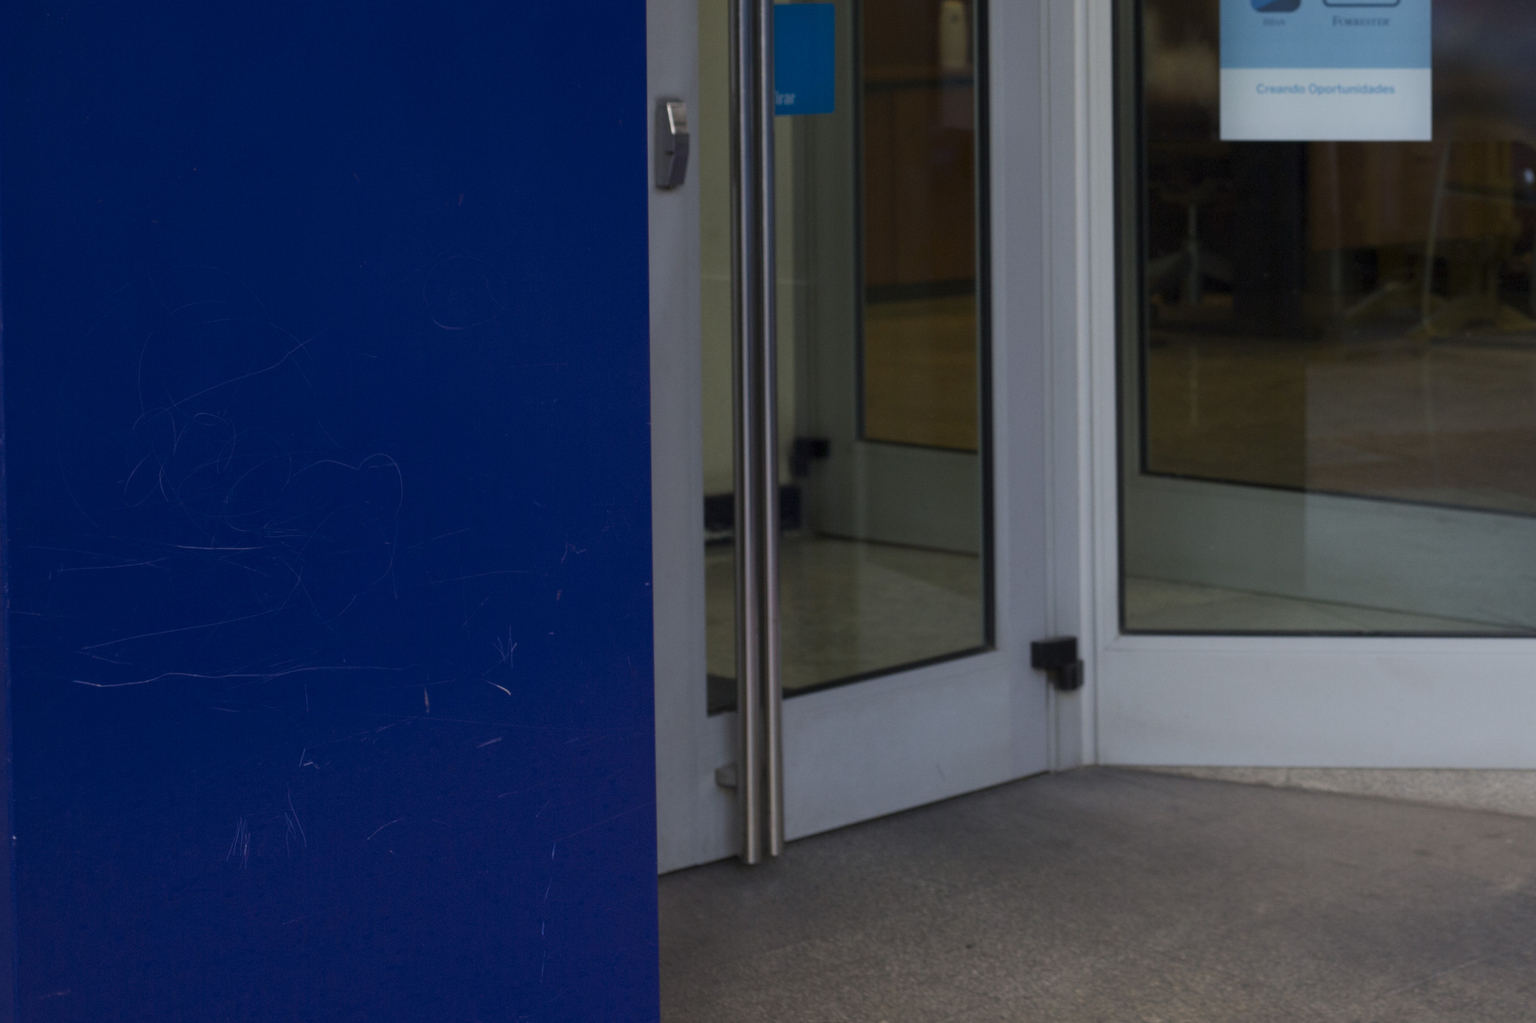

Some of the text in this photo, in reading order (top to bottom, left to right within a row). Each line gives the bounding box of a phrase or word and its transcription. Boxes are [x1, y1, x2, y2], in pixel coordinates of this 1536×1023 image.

[1256, 83, 1396, 97] Creando Oportunidades
[775, 90, 796, 106] irar
